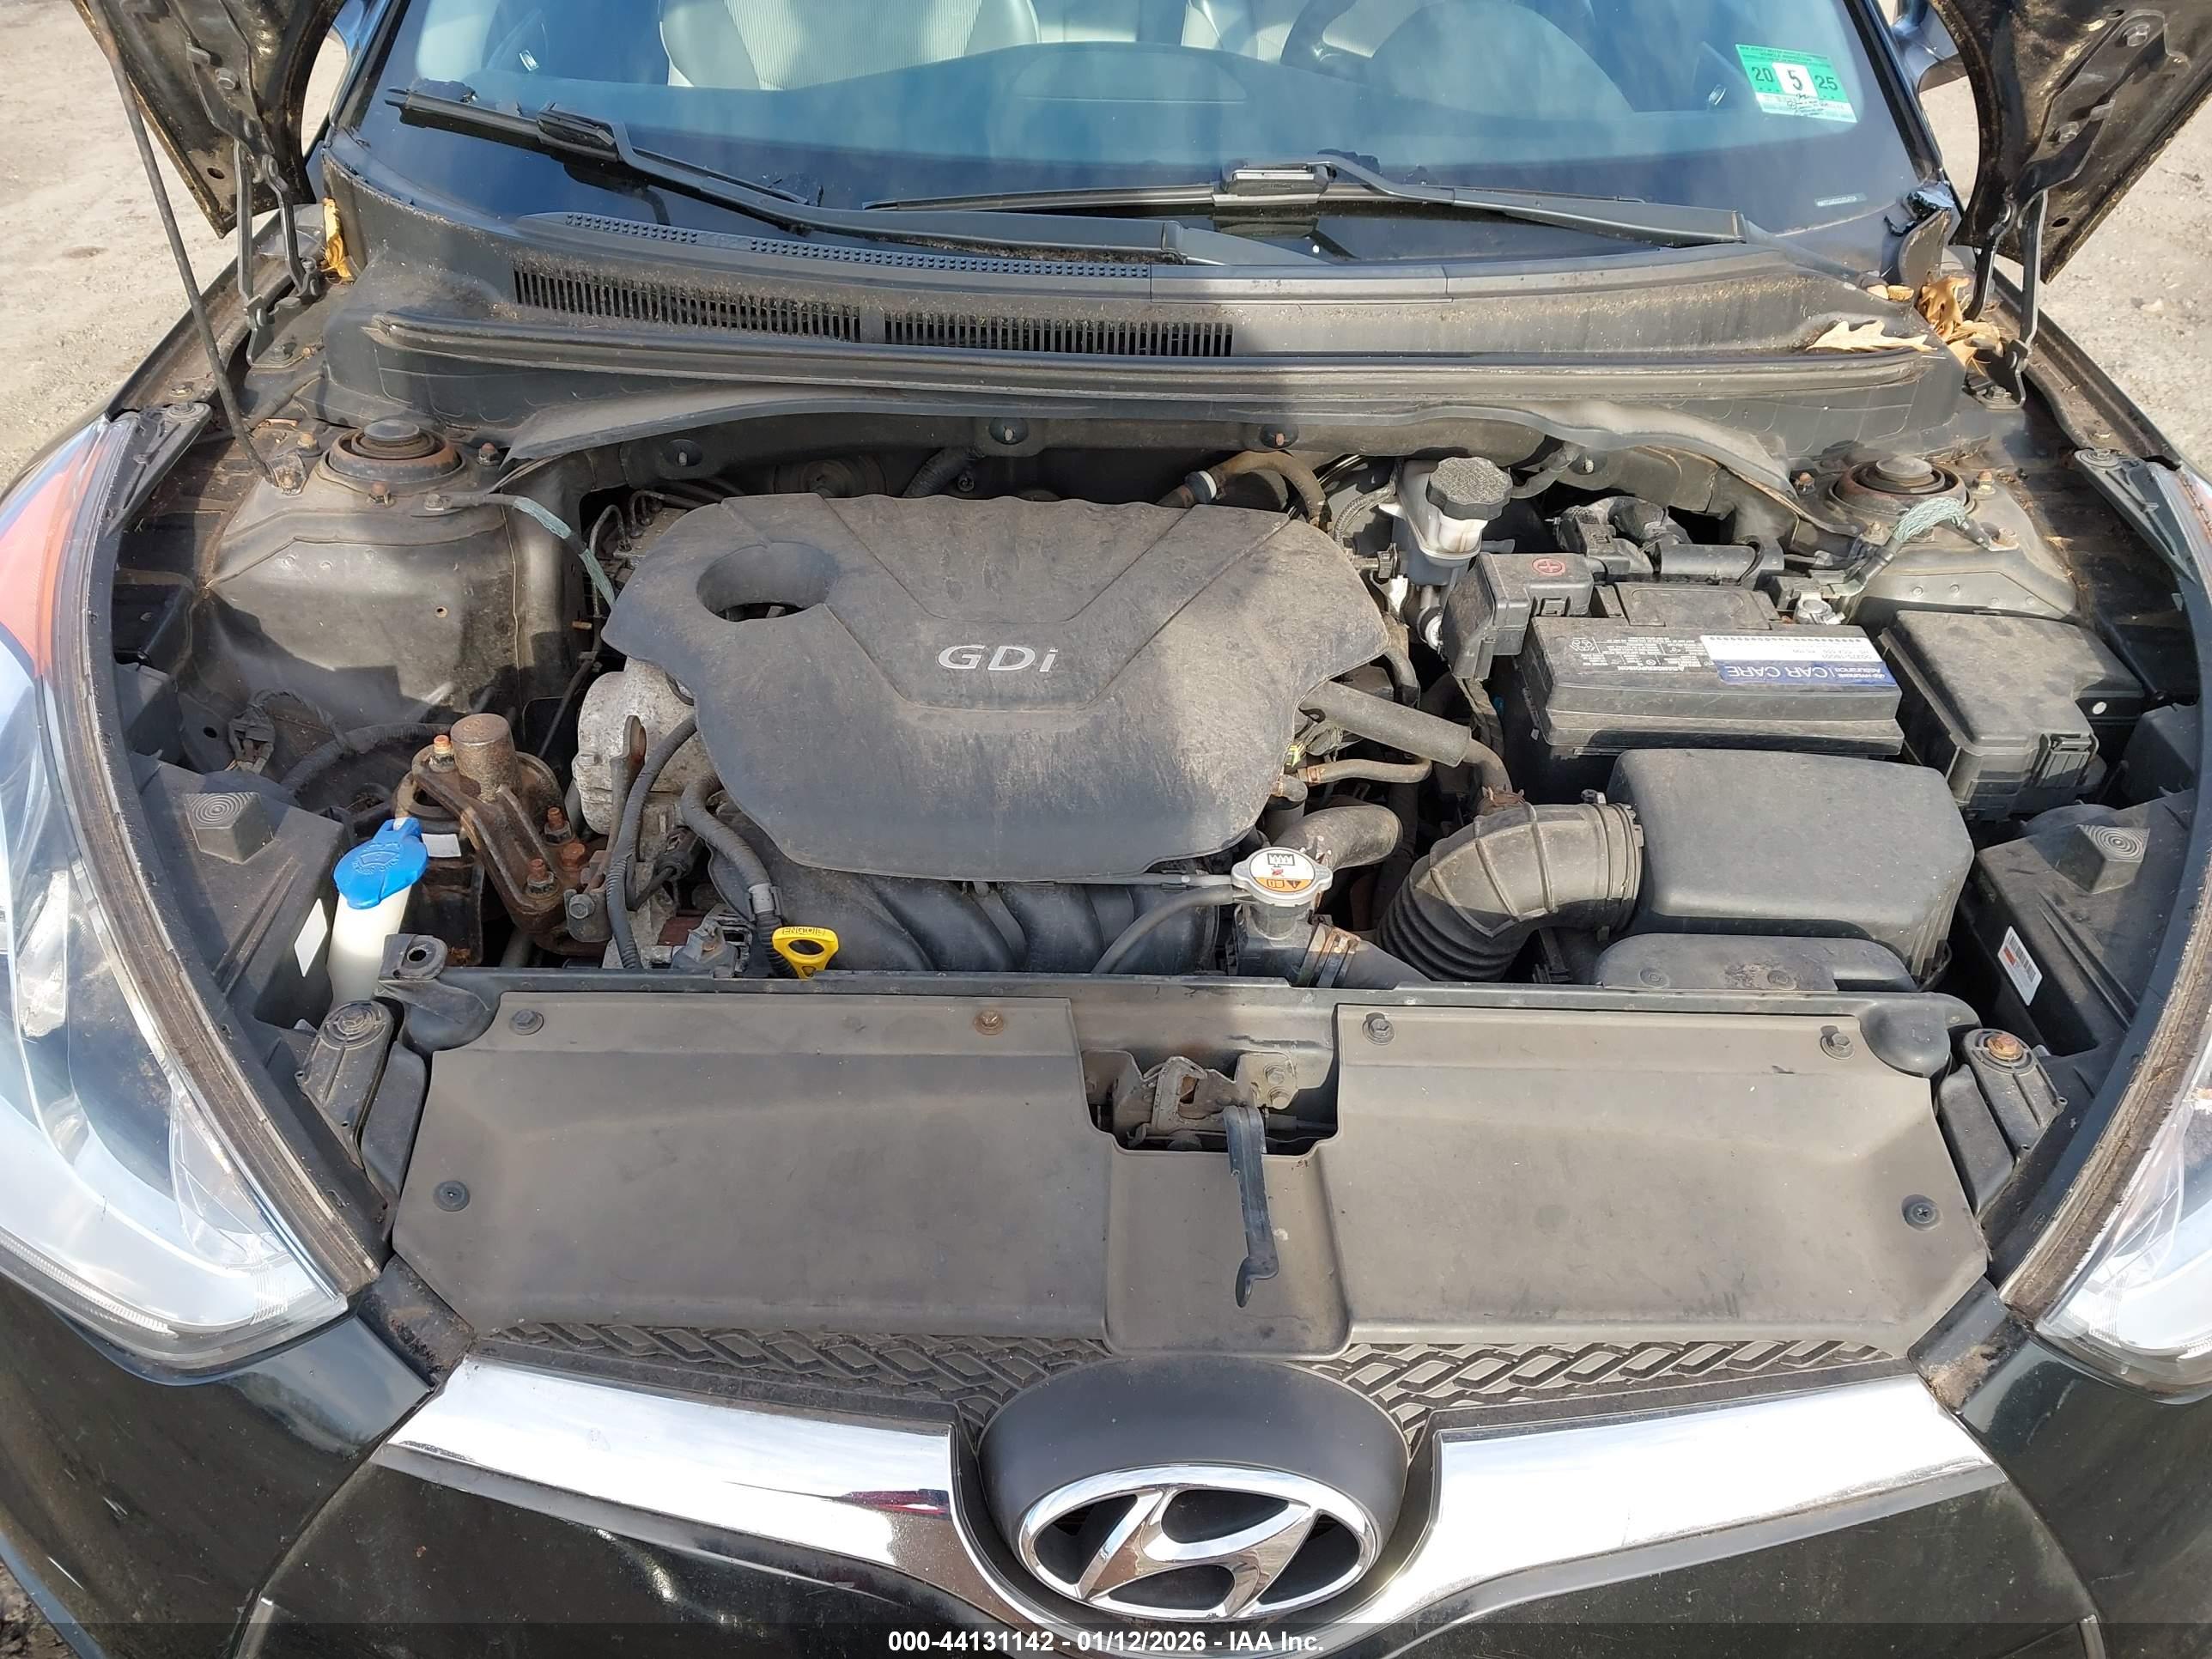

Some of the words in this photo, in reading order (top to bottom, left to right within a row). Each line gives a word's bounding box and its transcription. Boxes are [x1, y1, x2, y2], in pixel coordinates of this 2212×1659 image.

[1752, 67, 1774, 83] 20
[1787, 69, 1803, 91] 5
[1814, 75, 1838, 91] 25
[938, 644, 1059, 672] GDi
[1724, 665, 1781, 678] CARE
[1785, 665, 1828, 678] CAR
